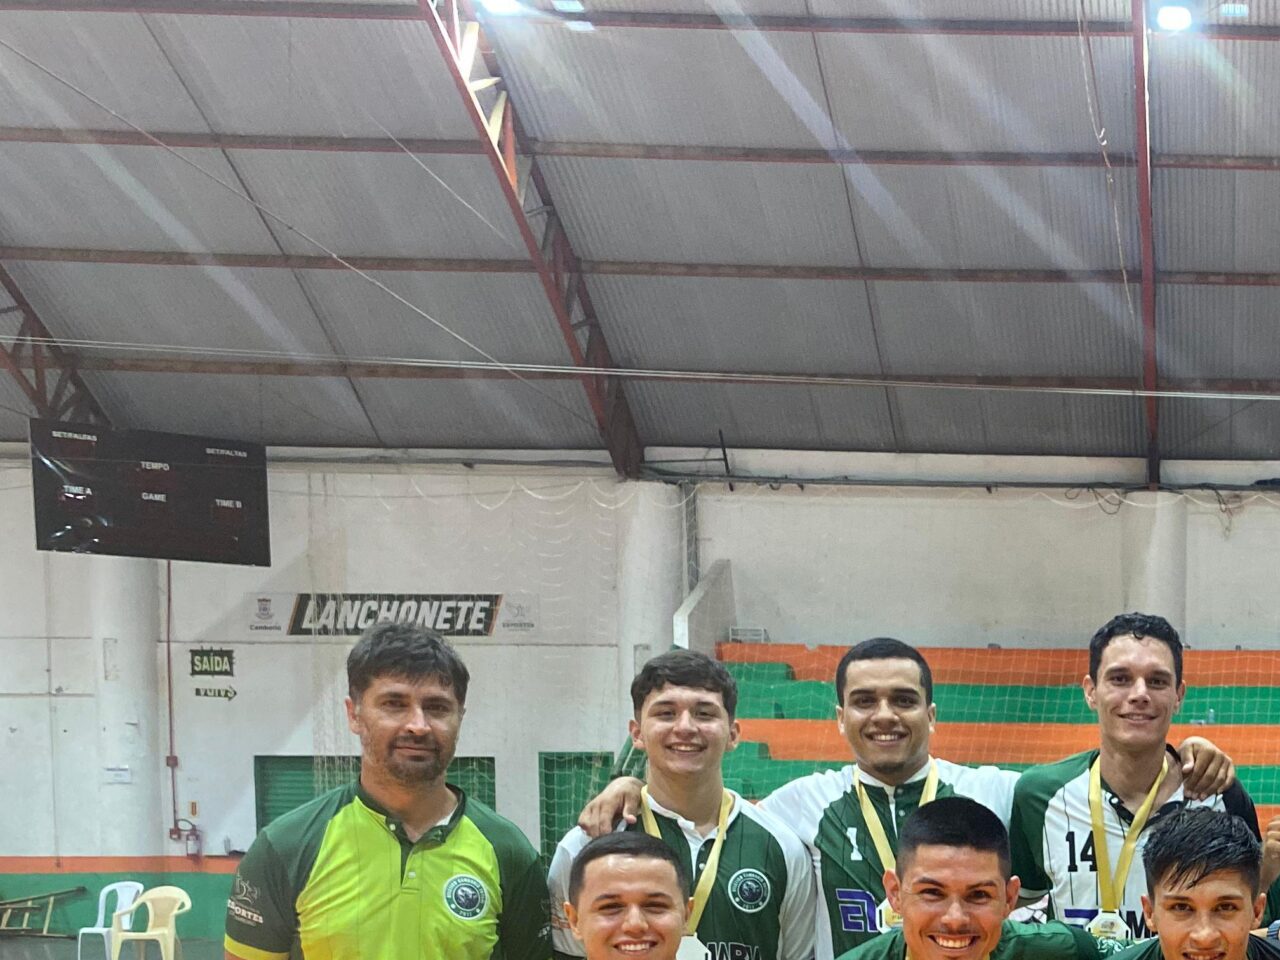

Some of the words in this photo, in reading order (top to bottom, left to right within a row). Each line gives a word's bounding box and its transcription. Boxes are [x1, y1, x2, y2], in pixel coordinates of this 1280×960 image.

[141, 461, 170, 471] TEMPO
[63, 485, 85, 495] TIME
[86, 487, 92, 496] A
[142, 492, 166, 502] GAME
[215, 499, 235, 508] TIME
[300, 600, 490, 631] LANCHONETE
[194, 652, 230, 672] SAÍDA
[846, 827, 863, 862] 1
[1065, 831, 1098, 873] 14
